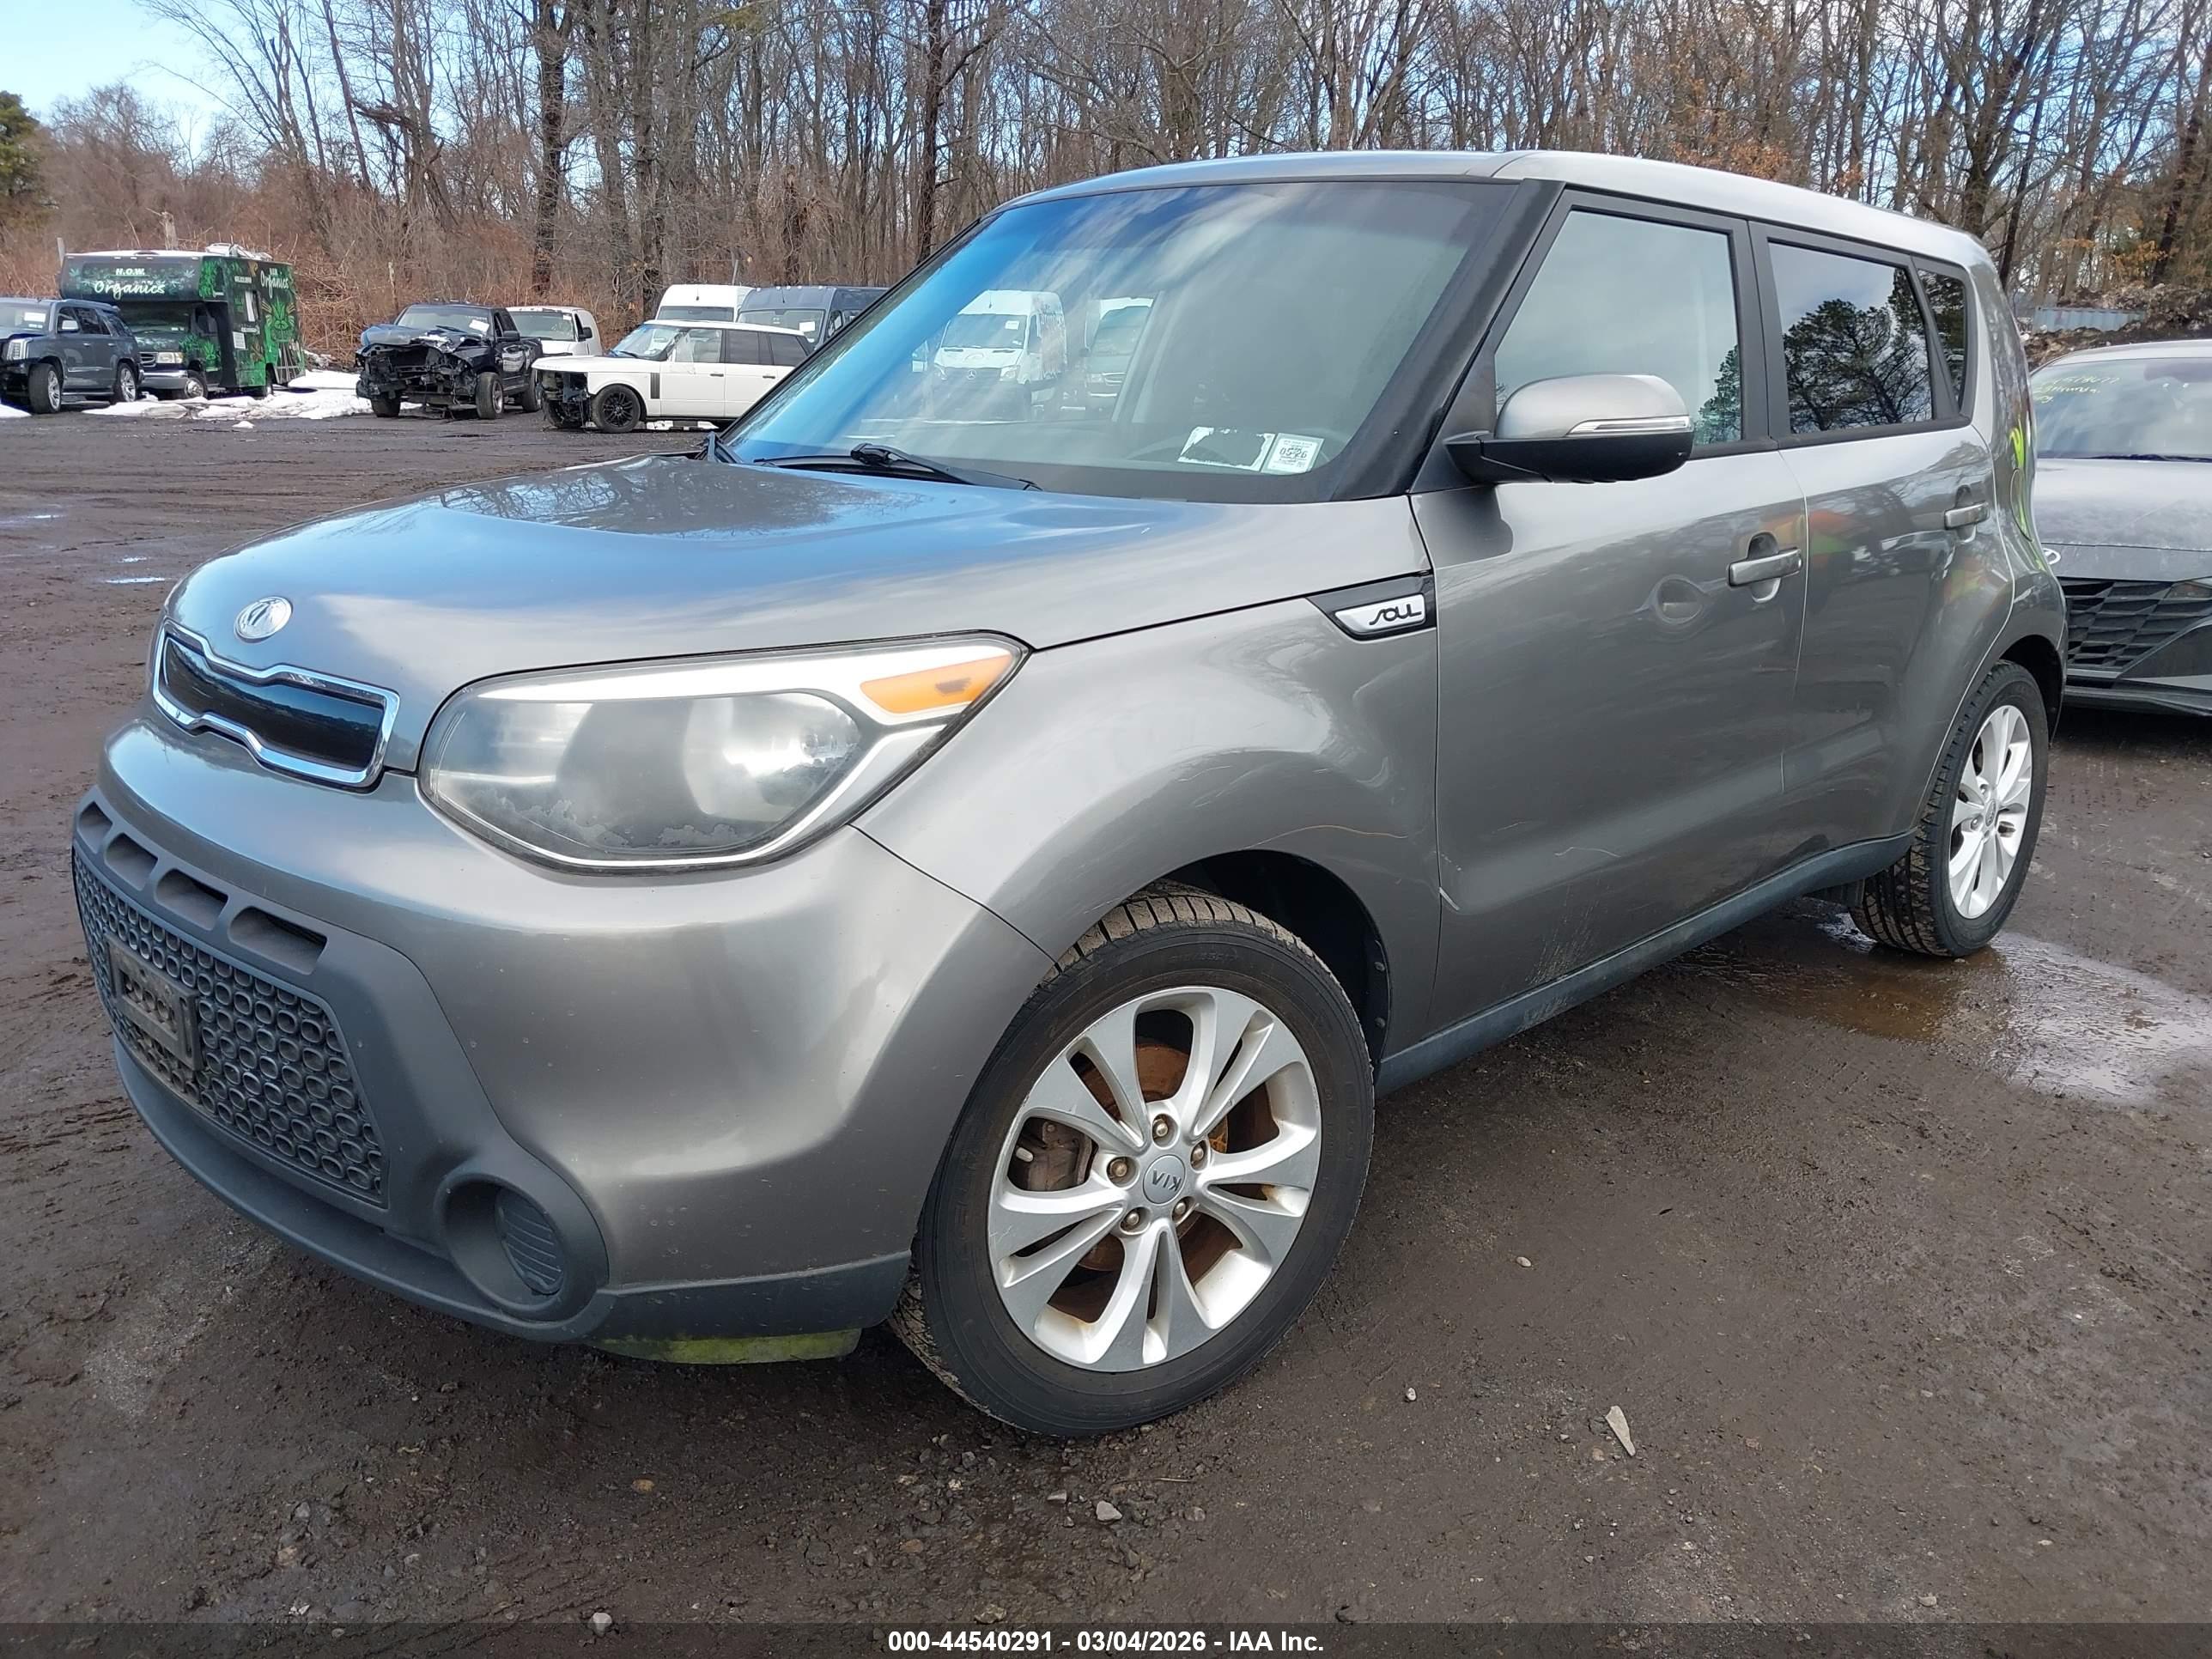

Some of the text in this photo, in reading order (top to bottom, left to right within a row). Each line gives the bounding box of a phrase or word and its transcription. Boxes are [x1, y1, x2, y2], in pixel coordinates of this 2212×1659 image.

[94, 280, 166, 301] Organics
[260, 270, 289, 299] Organics
[1152, 1168, 1182, 1192] KIA
